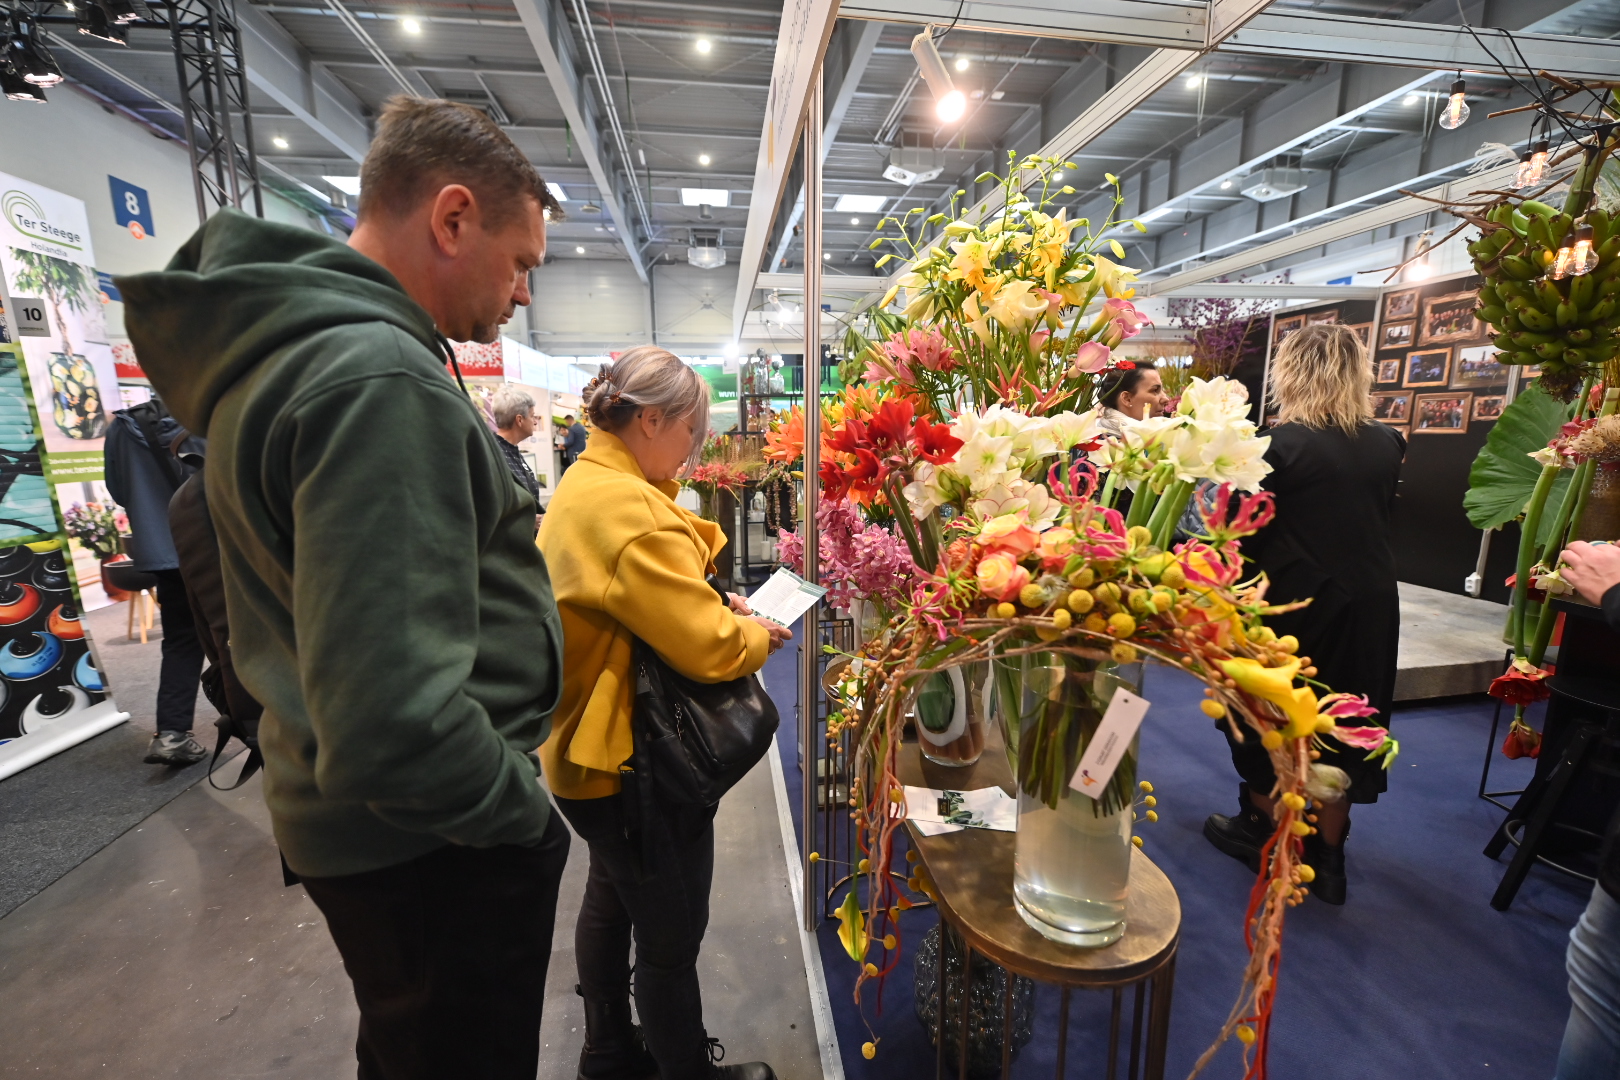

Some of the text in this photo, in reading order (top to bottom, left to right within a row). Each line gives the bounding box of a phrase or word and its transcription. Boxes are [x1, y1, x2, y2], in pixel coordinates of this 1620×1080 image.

[124, 191, 140, 215] 8
[15, 213, 81, 242] Ter Steege
[31, 241, 68, 257] Holandia
[22, 307, 42, 321] 10
